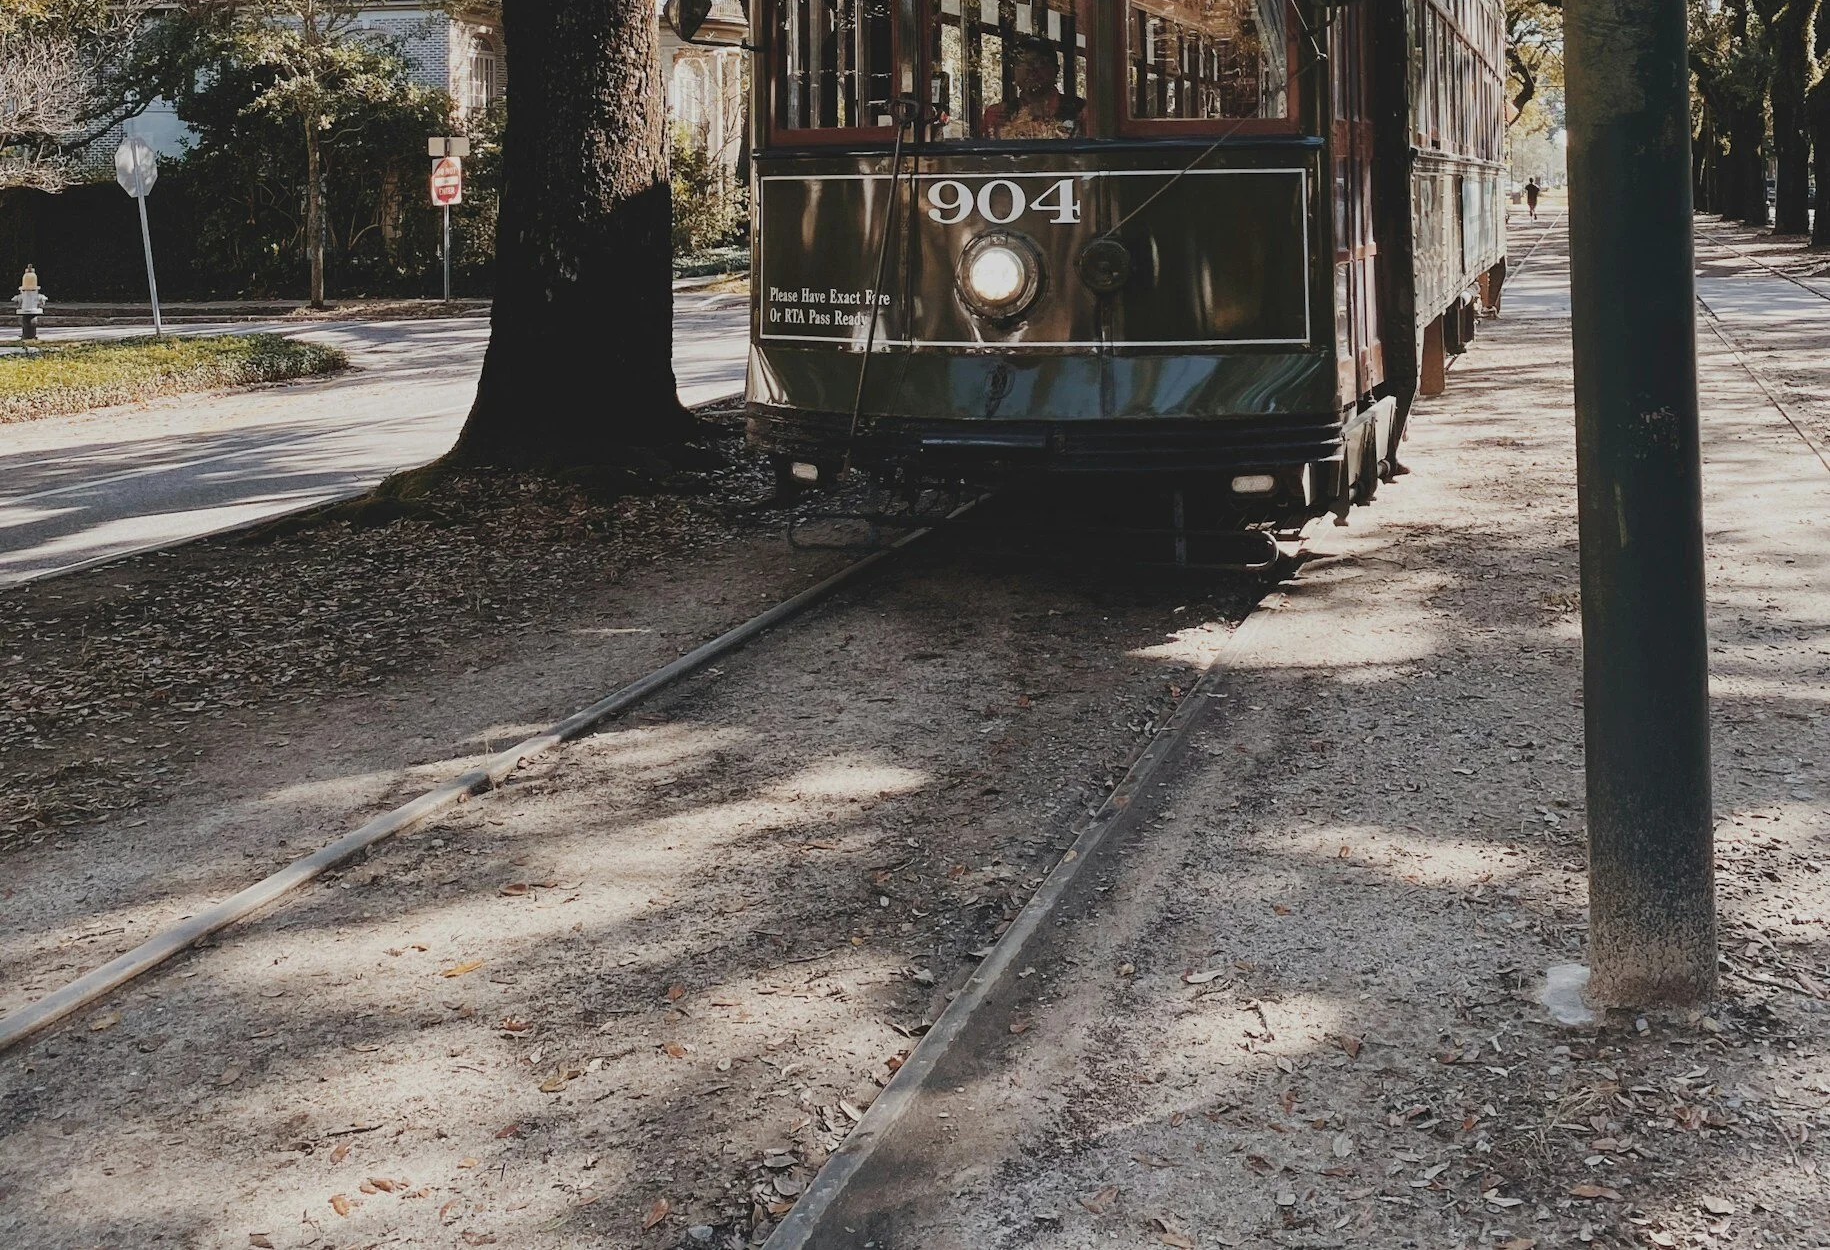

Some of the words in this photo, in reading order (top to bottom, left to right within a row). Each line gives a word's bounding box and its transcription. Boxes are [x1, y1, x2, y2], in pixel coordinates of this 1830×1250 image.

[927, 178, 1081, 224] 904
[769, 287, 798, 302] Please
[801, 288, 826, 304] Have
[829, 288, 861, 305] Exact
[769, 307, 782, 323] Or
[784, 308, 806, 324] RTA
[808, 309, 831, 325] Pass
[834, 309, 868, 328] Ready
